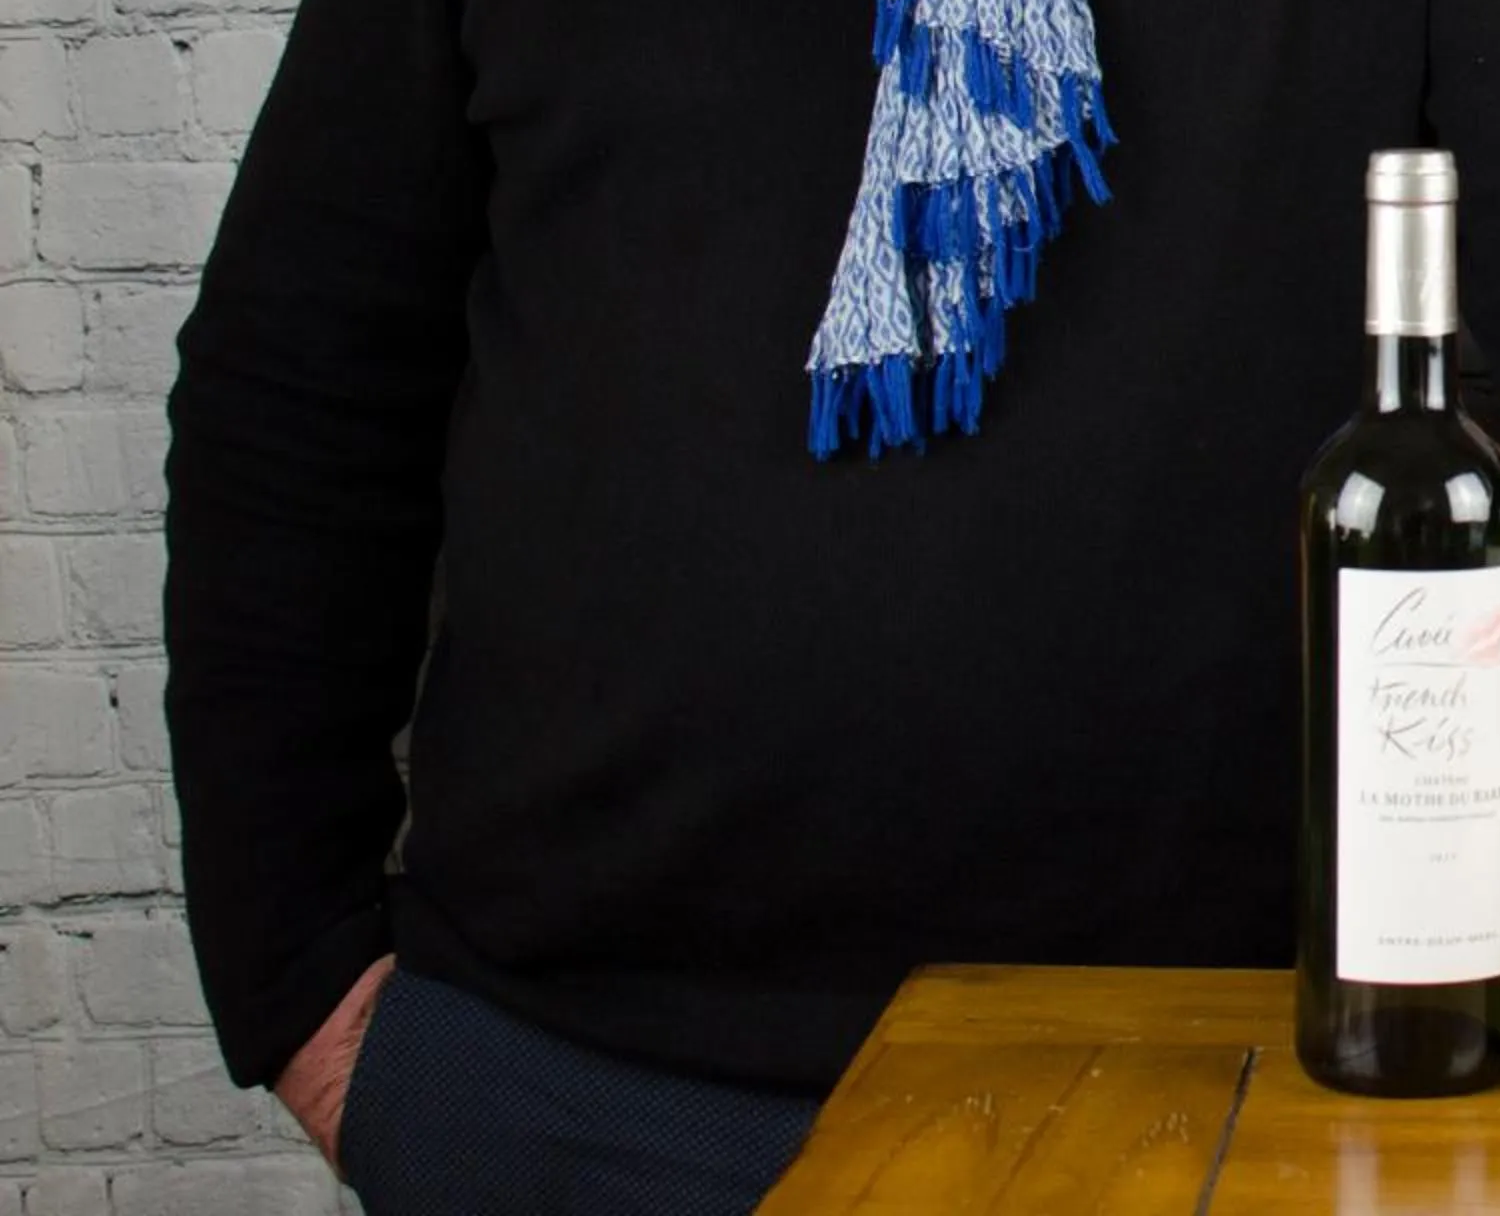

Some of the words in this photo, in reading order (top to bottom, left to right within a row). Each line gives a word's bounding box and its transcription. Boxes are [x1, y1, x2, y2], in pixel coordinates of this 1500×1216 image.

[1369, 672, 1470, 713] French
[1378, 714, 1474, 761] Kiss
[1448, 791, 1469, 806] DU
